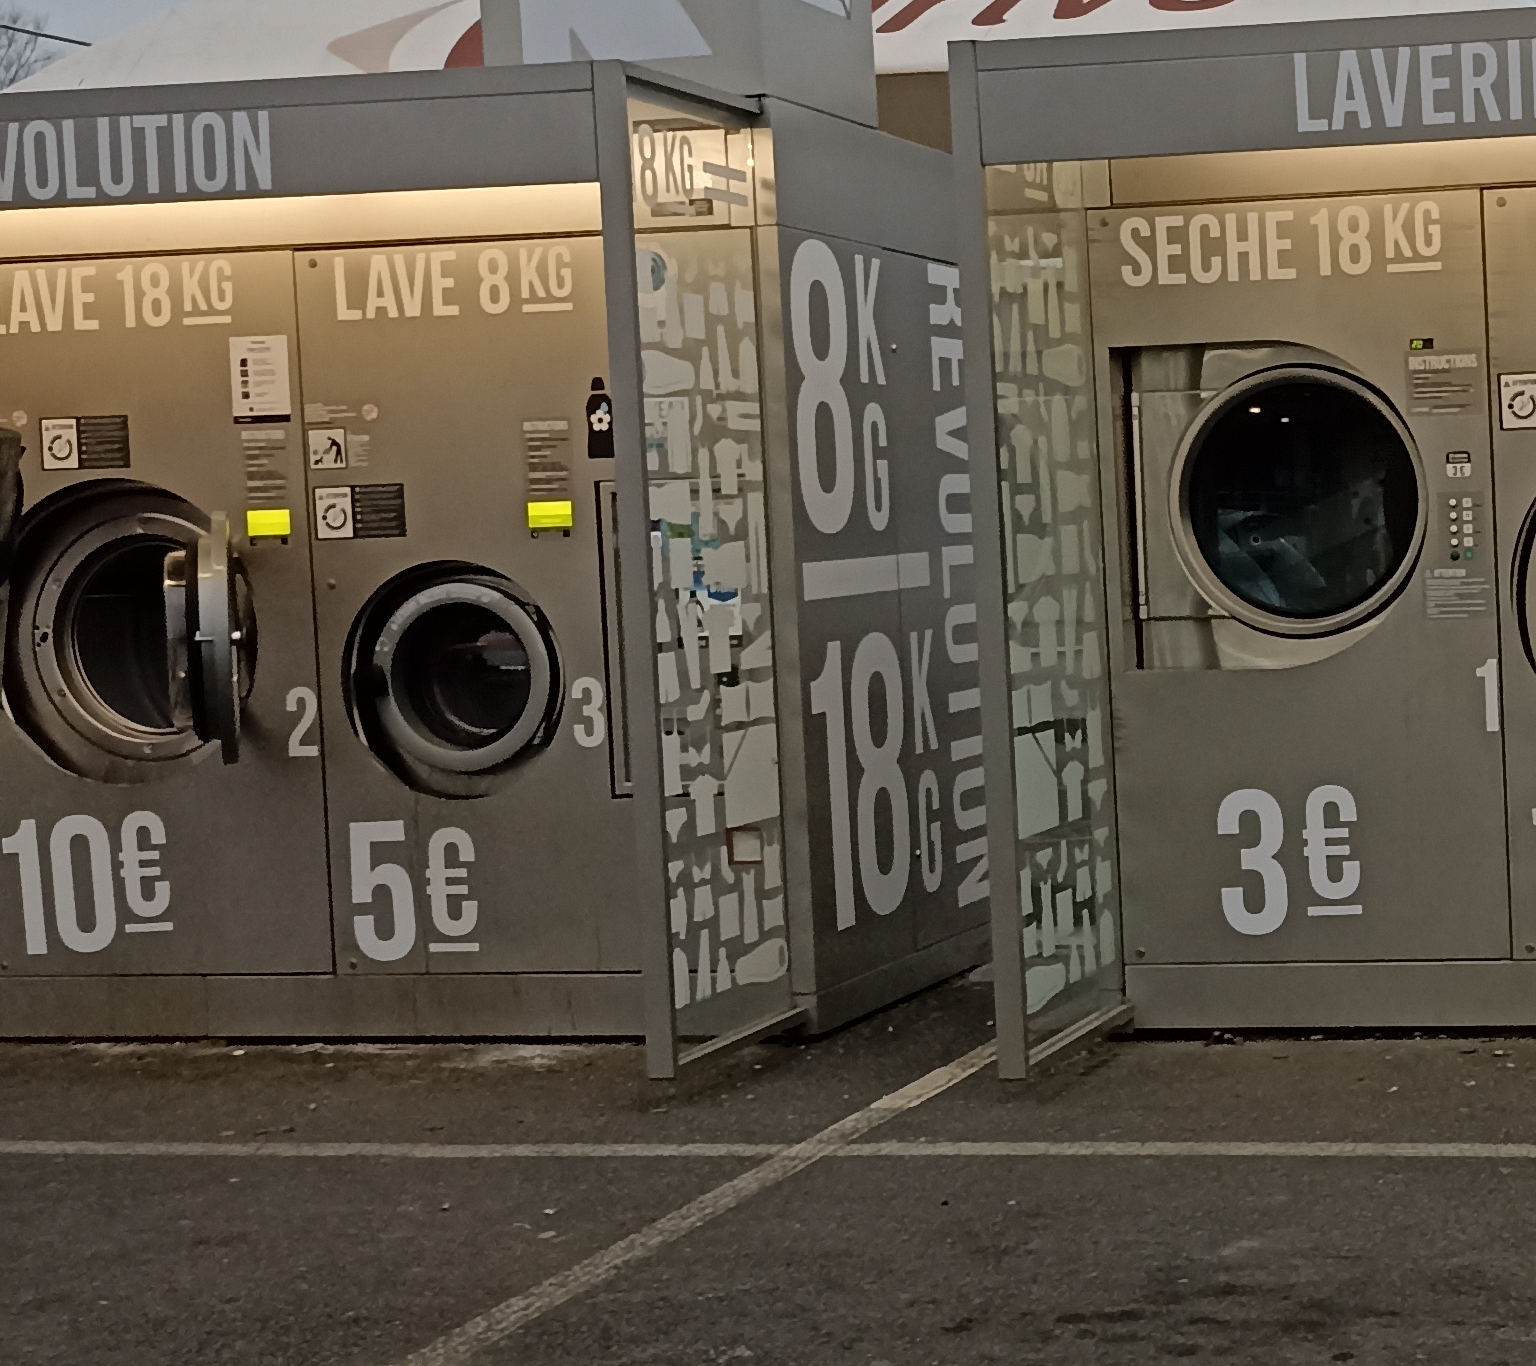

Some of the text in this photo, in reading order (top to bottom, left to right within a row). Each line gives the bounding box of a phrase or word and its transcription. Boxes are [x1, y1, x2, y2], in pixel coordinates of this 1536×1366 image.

[1120, 201, 1442, 287] SECHE 18 KG
[0, 259, 233, 335] AVE 18 KG
[334, 245, 573, 321] LAVE 8 KG
[790, 238, 855, 534] 8
[285, 686, 320, 757] 2
[571, 676, 606, 748] 3
[1475, 658, 1500, 733] 1
[810, 631, 911, 930] 18
[1, 810, 174, 955] 10€
